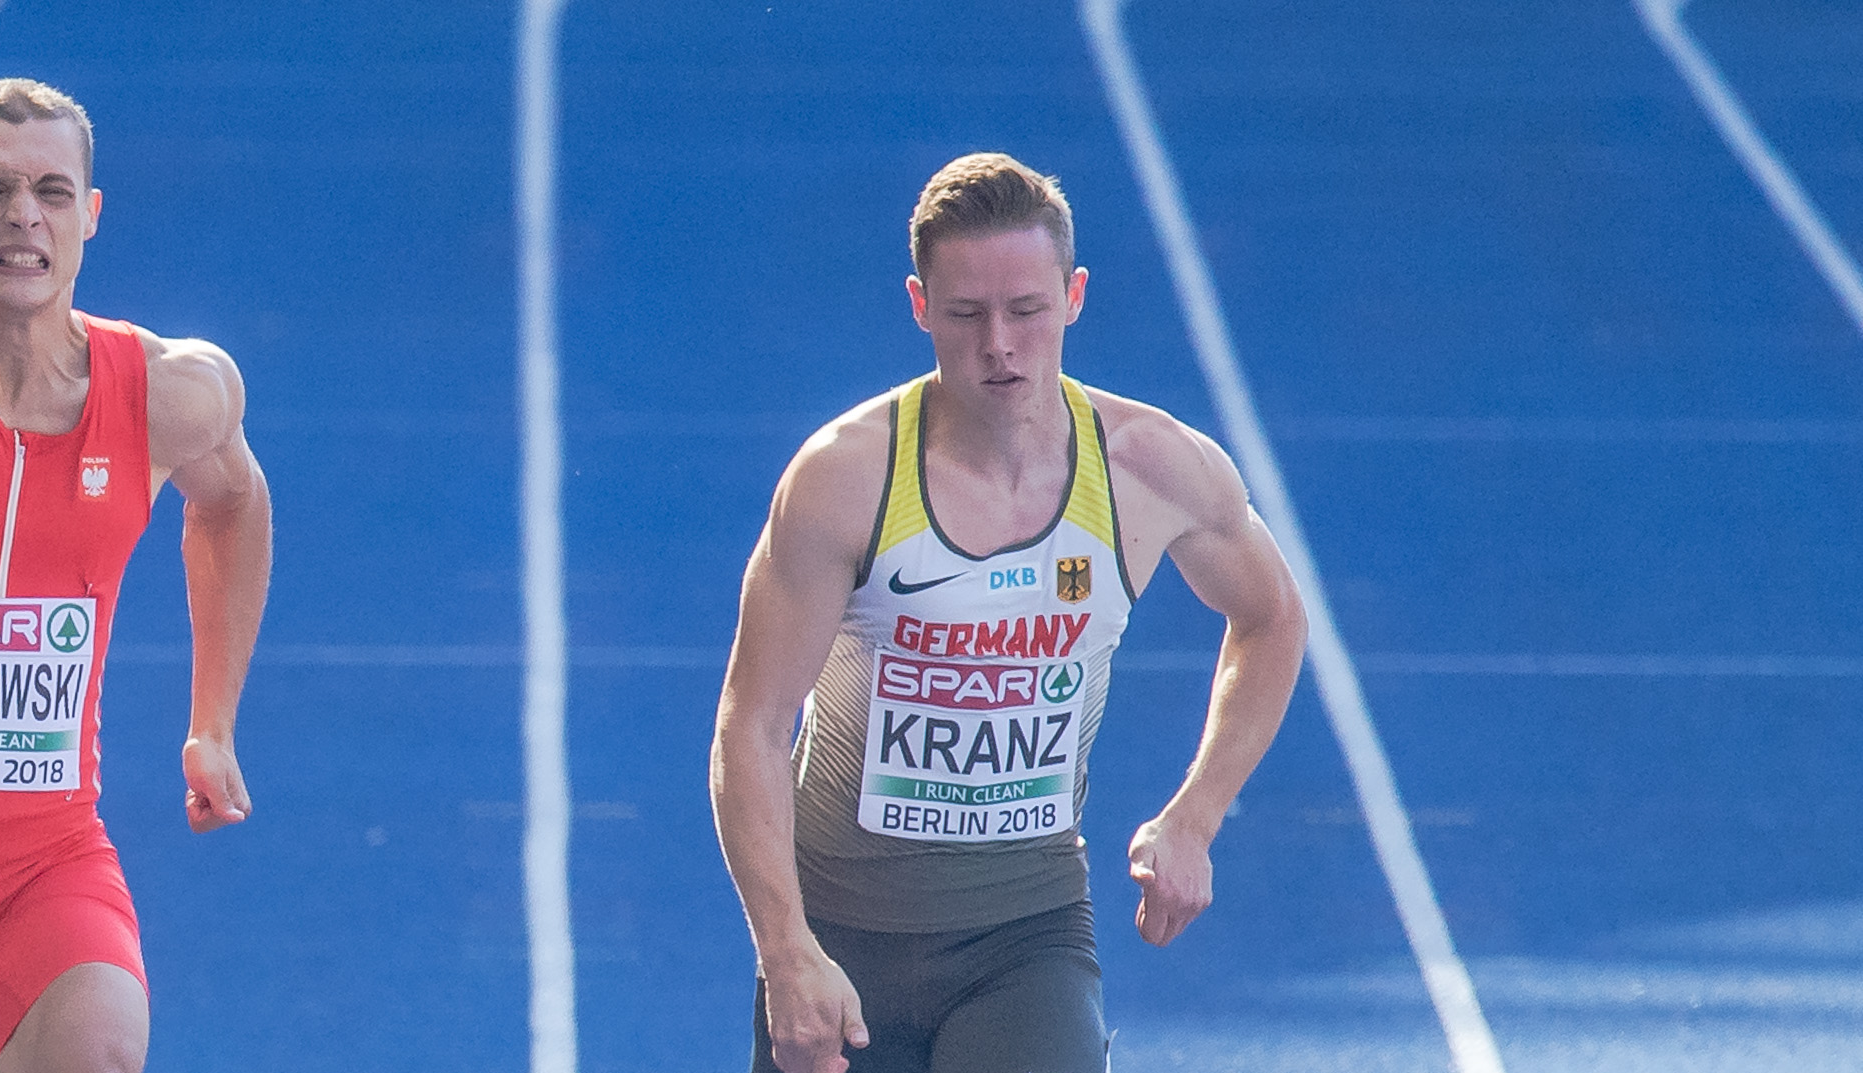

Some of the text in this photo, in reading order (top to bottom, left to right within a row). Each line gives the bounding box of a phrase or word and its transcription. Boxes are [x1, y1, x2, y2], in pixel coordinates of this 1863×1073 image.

[989, 566, 1037, 590] DKB
[893, 612, 1091, 659] GERMANY
[882, 664, 1035, 703] SPAR
[880, 709, 1073, 776] KRANZ
[3, 759, 64, 784] 2018
[914, 783, 920, 798] I
[926, 784, 967, 801] RUN
[882, 803, 1056, 835] BERLIN 2018
